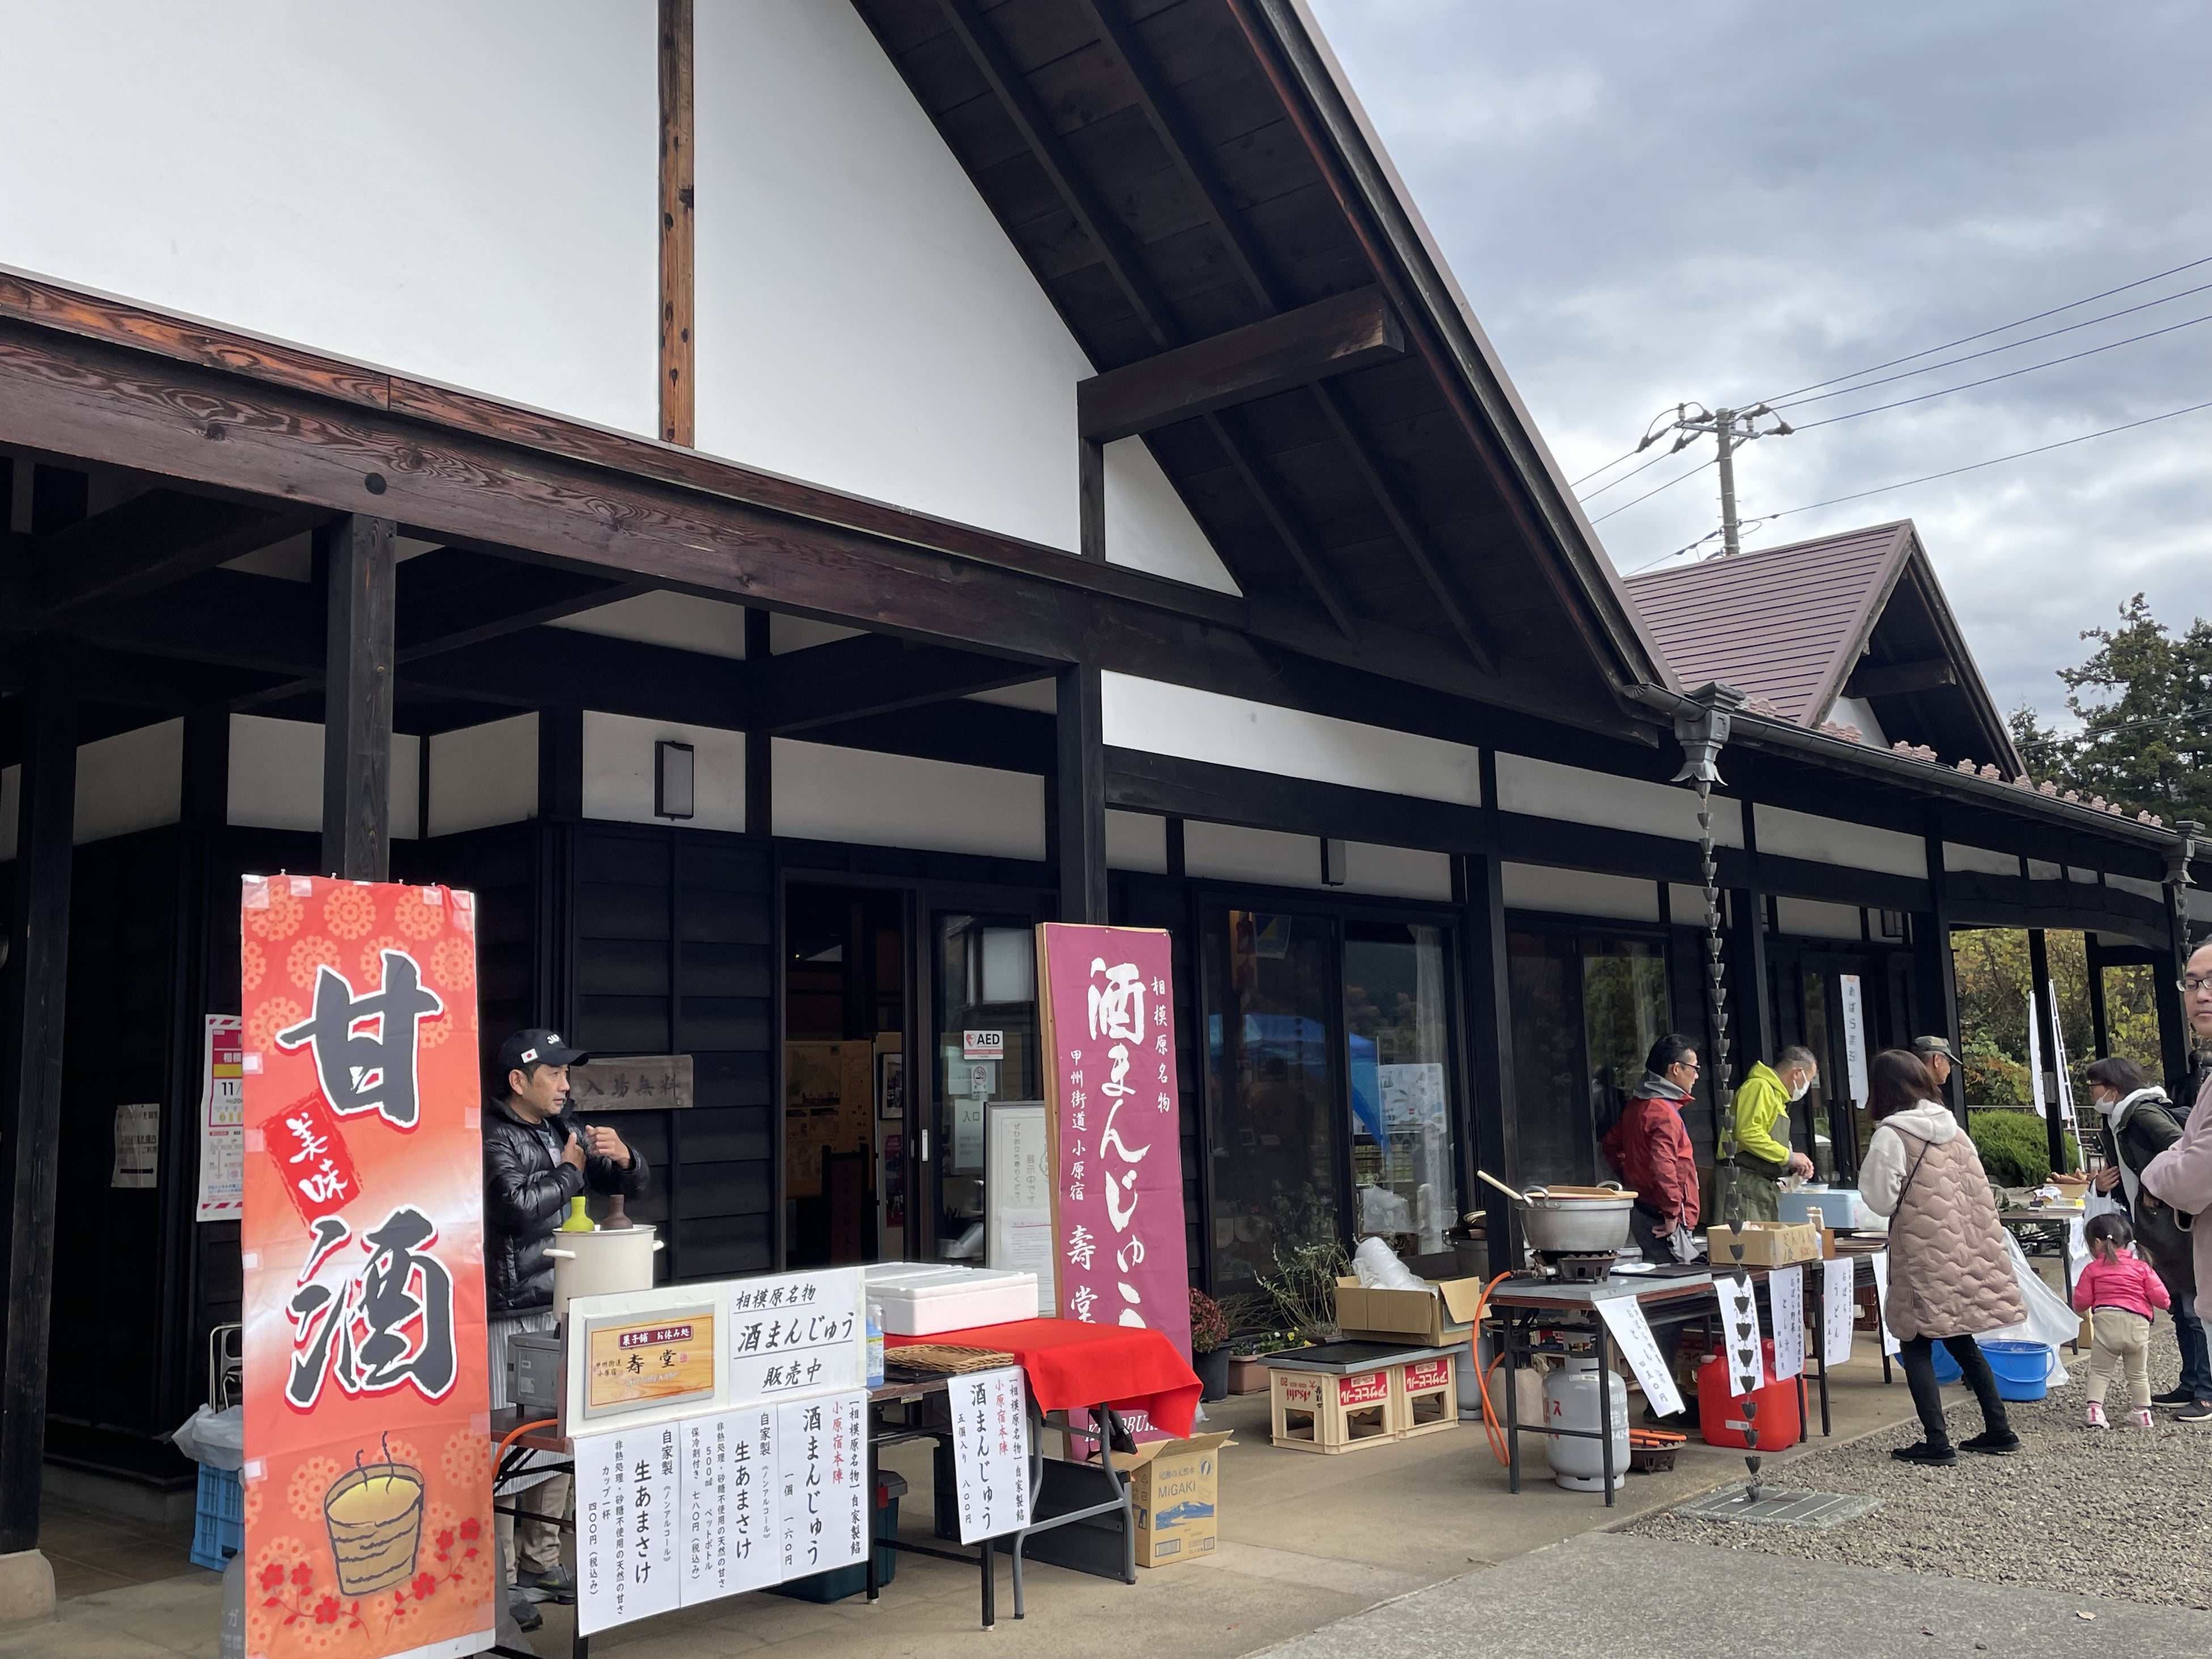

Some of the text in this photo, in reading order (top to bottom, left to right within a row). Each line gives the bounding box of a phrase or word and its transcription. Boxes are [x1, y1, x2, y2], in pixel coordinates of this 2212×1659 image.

[977, 1033, 1000, 1045] AED
[1150, 976, 1170, 1113] 相模原名物
[1070, 1050, 1087, 1132] 甲州街道
[963, 1111, 980, 1122] 入口
[275, 948, 457, 1409] 甘酒
[1069, 1140, 1086, 1202] 小原宿
[736, 1283, 816, 1310] 相模原名物
[657, 1328, 690, 1340] お休み処
[737, 1312, 854, 1353] 酒まんじゅう
[762, 1358, 822, 1388] 販売中
[1286, 1388, 1311, 1403] Asahi
[1341, 1384, 1387, 1403] アサヒビール
[1407, 1371, 1447, 1389] アサヒビール
[760, 1412, 771, 1456] 自家製
[957, 1413, 968, 1463] 五個入り
[995, 1379, 1008, 1455] 小原宿本陣
[662, 1429, 673, 1475] 自家製
[691, 1427, 700, 1479] 保冷剤付き
[833, 1401, 844, 1484] 小原宿本陣
[970, 1383, 992, 1530] 酒まんじゅう
[602, 1466, 611, 1520] カップ一杯
[734, 1440, 752, 1559] 生あまさけ
[803, 1405, 822, 1565] 酒まんじゅう
[1158, 1480, 1196, 1498] MIGAKI
[634, 1459, 652, 1584] 生あまさけ
